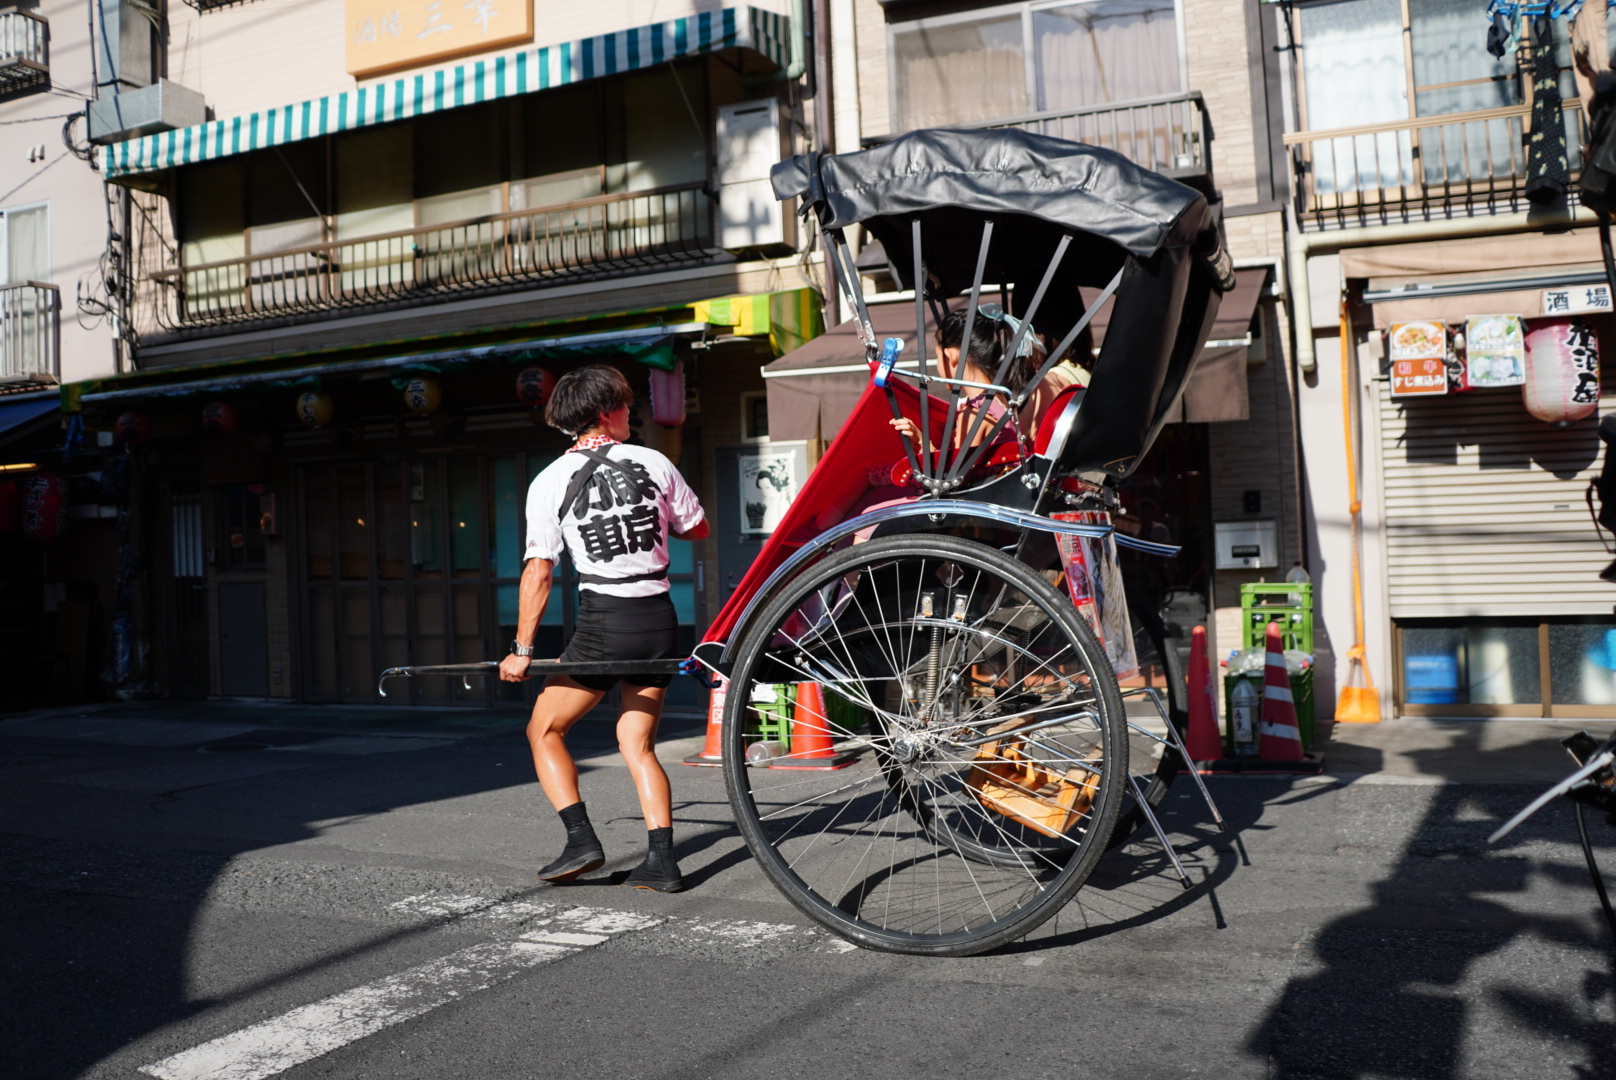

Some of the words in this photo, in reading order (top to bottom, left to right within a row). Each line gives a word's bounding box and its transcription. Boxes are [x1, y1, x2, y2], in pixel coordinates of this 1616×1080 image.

[354, 9, 402, 44] 酒場
[1547, 287, 1609, 312] 酒場
[1398, 360, 1437, 375] 和牛
[1394, 375, 1445, 388] すじ煮込み
